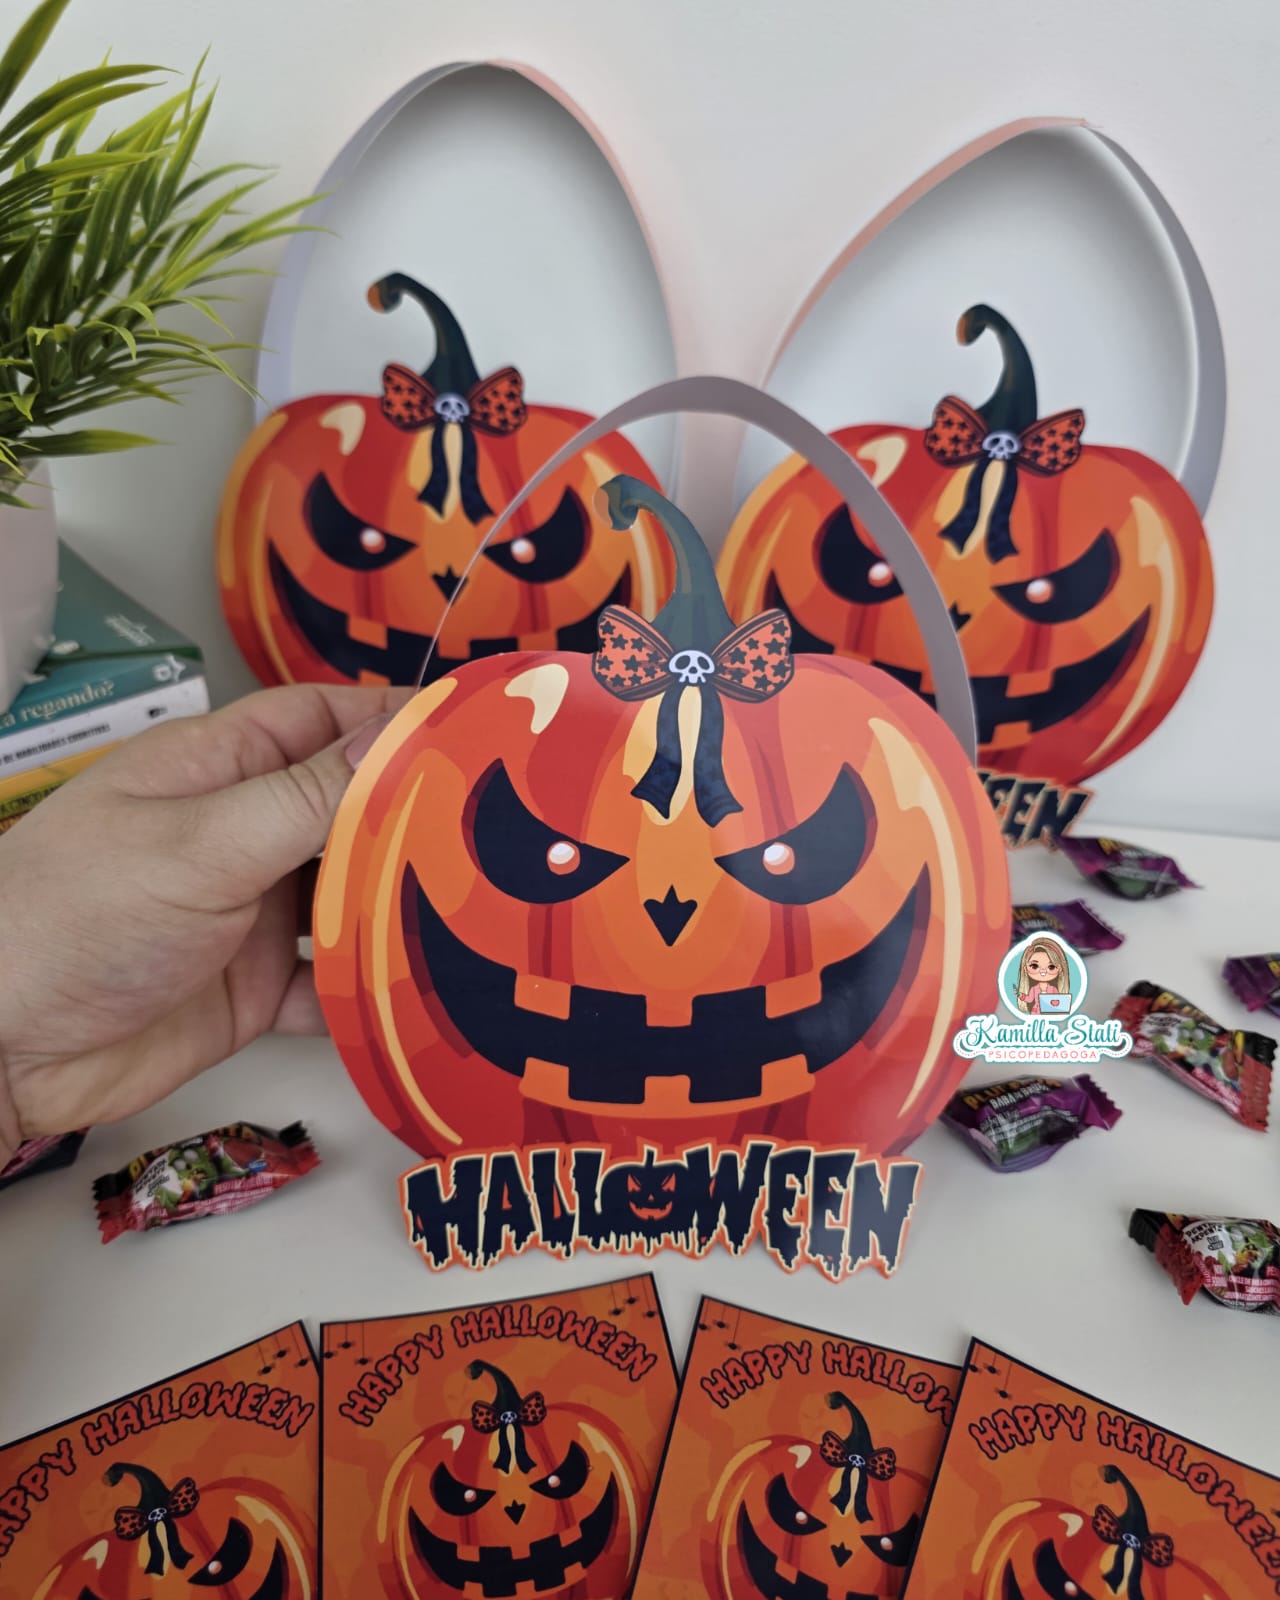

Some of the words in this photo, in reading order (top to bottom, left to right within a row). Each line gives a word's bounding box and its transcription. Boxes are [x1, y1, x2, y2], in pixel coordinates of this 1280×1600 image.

[21, 679, 114, 720] regando?
[404, 1139, 924, 1279] HALLOWEEN
[340, 1325, 444, 1426] HAPPY
[450, 1304, 658, 1381] HALLOWEEN
[700, 1340, 812, 1409] HAPPY
[0, 1437, 77, 1557] APPY
[82, 1381, 316, 1455] HALLOWEEN
[968, 1404, 1086, 1460] HAPPY
[1097, 1411, 1280, 1597] HALLOWEE
